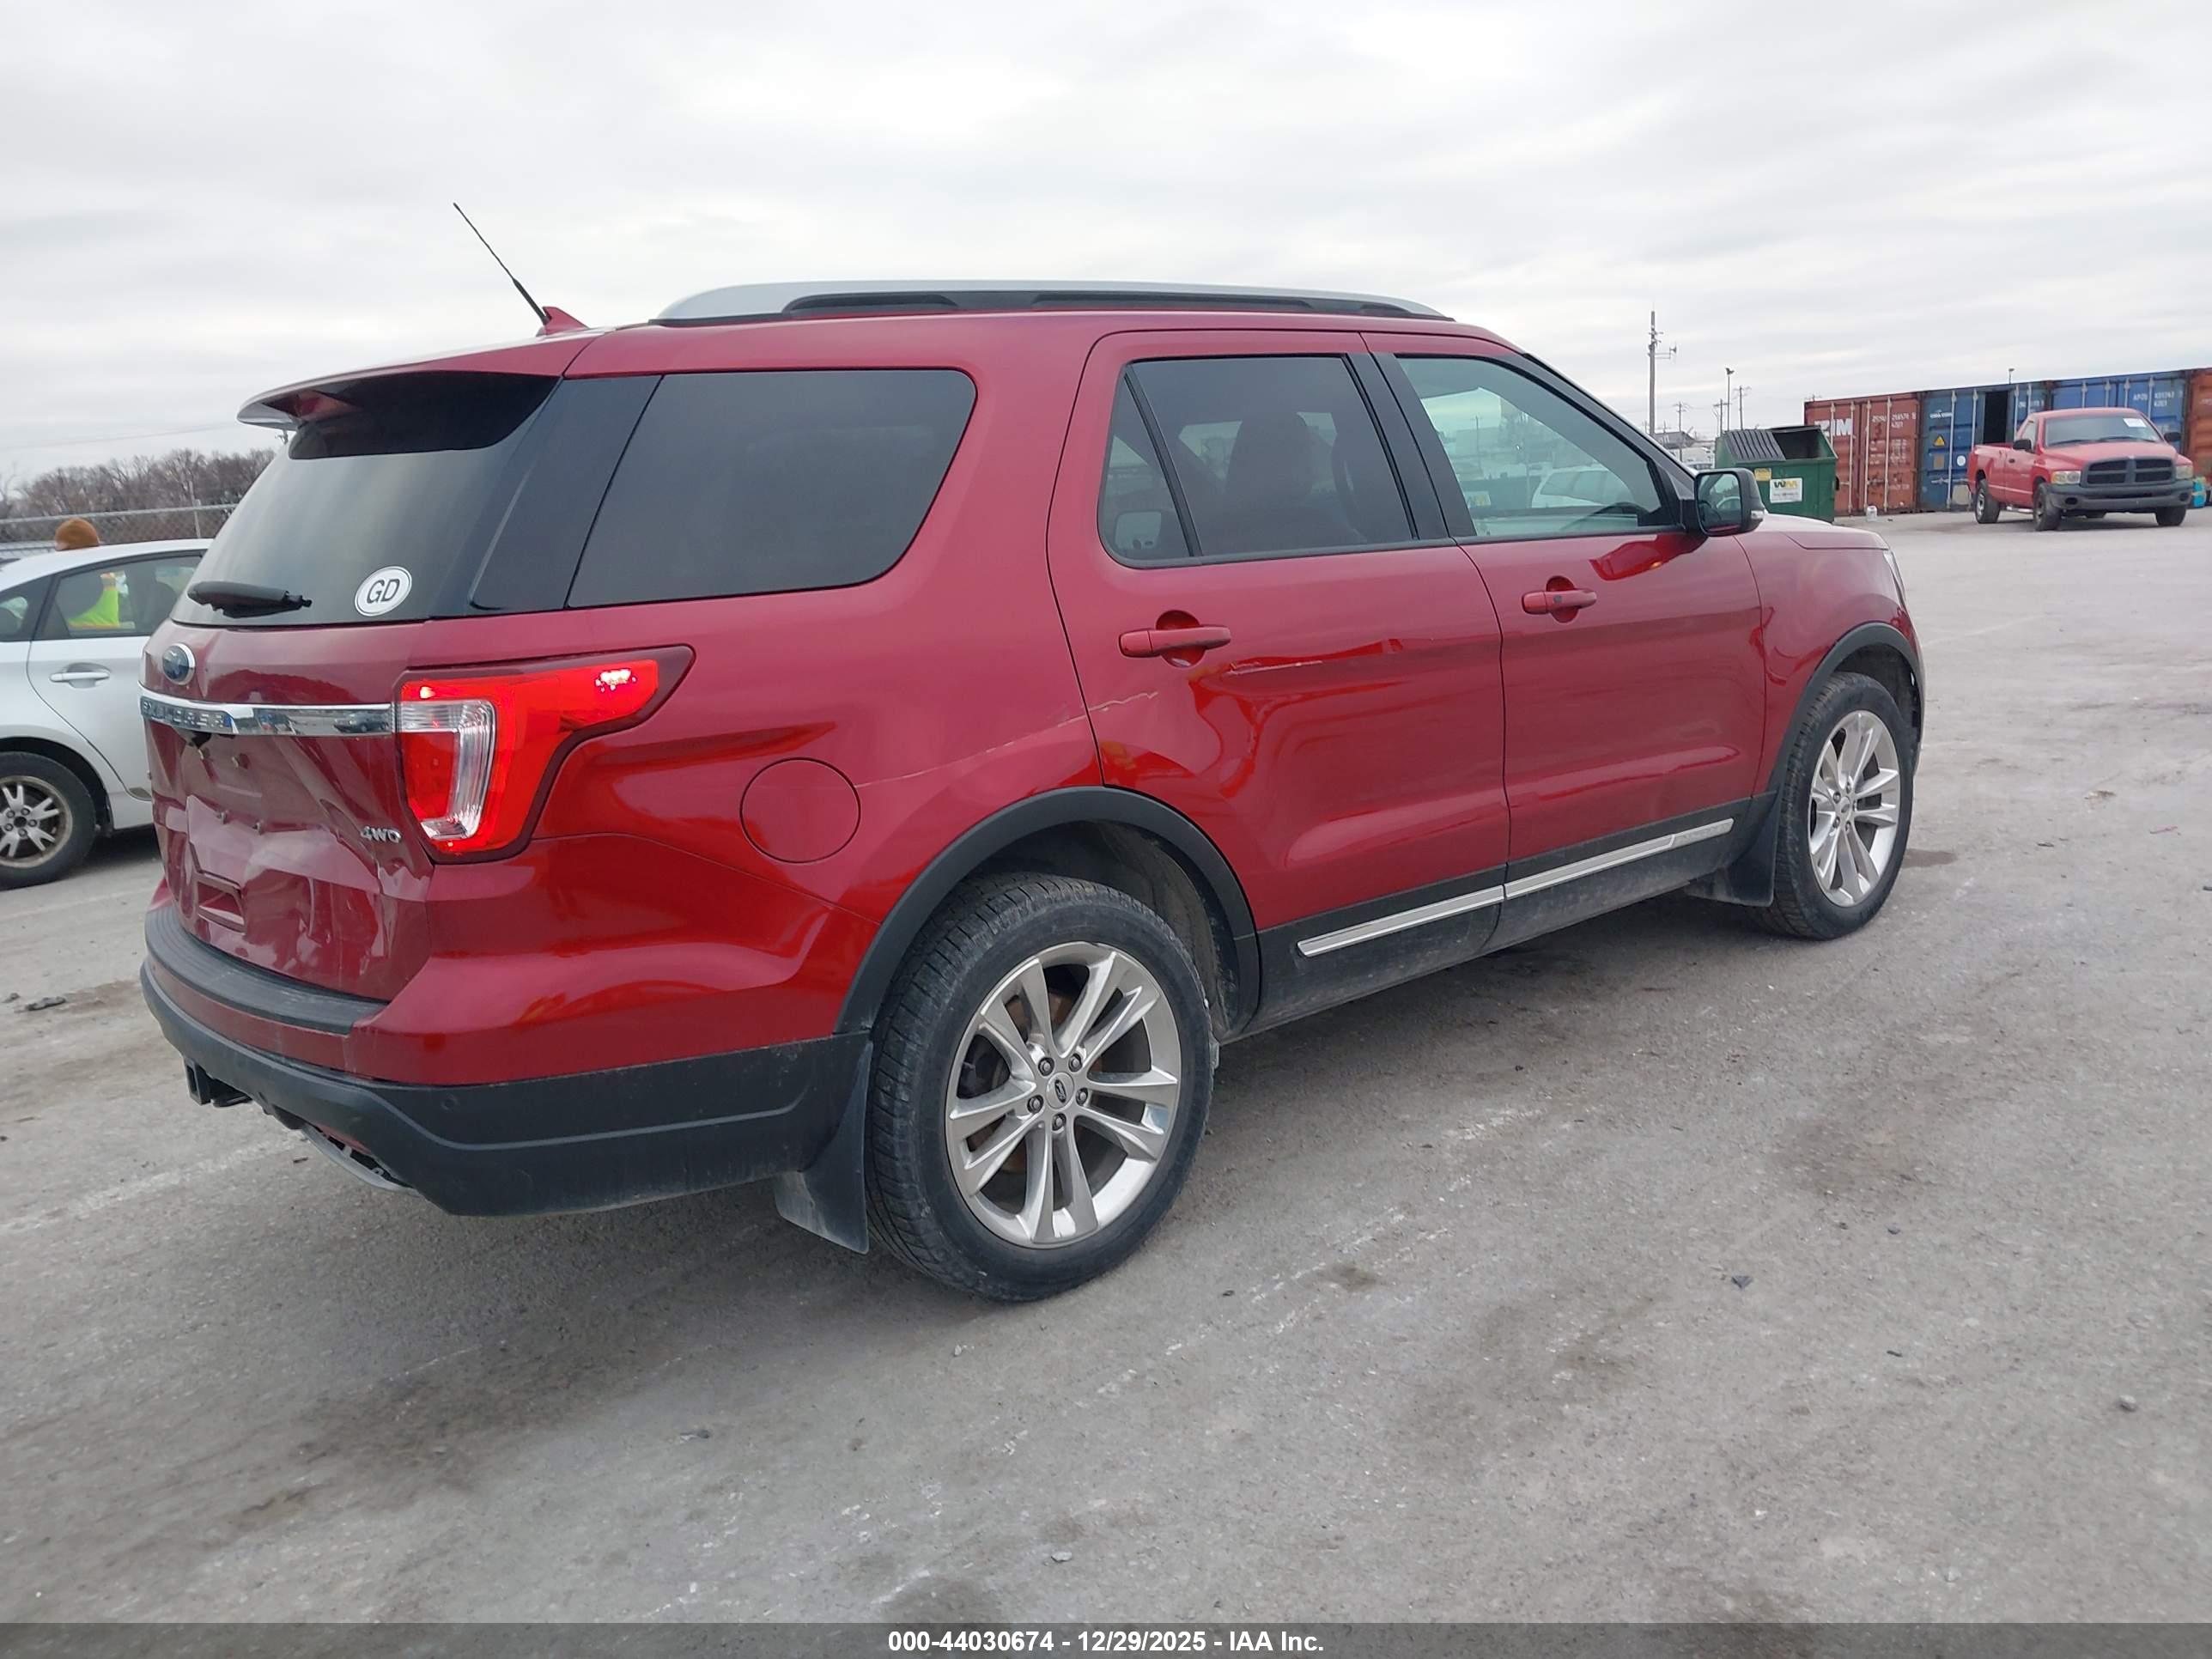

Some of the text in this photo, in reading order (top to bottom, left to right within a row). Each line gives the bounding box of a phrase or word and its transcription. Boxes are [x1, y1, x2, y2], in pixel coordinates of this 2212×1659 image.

[1773, 480, 1798, 489] WM
[367, 579, 400, 604] GD
[361, 825, 402, 843] 4WD
